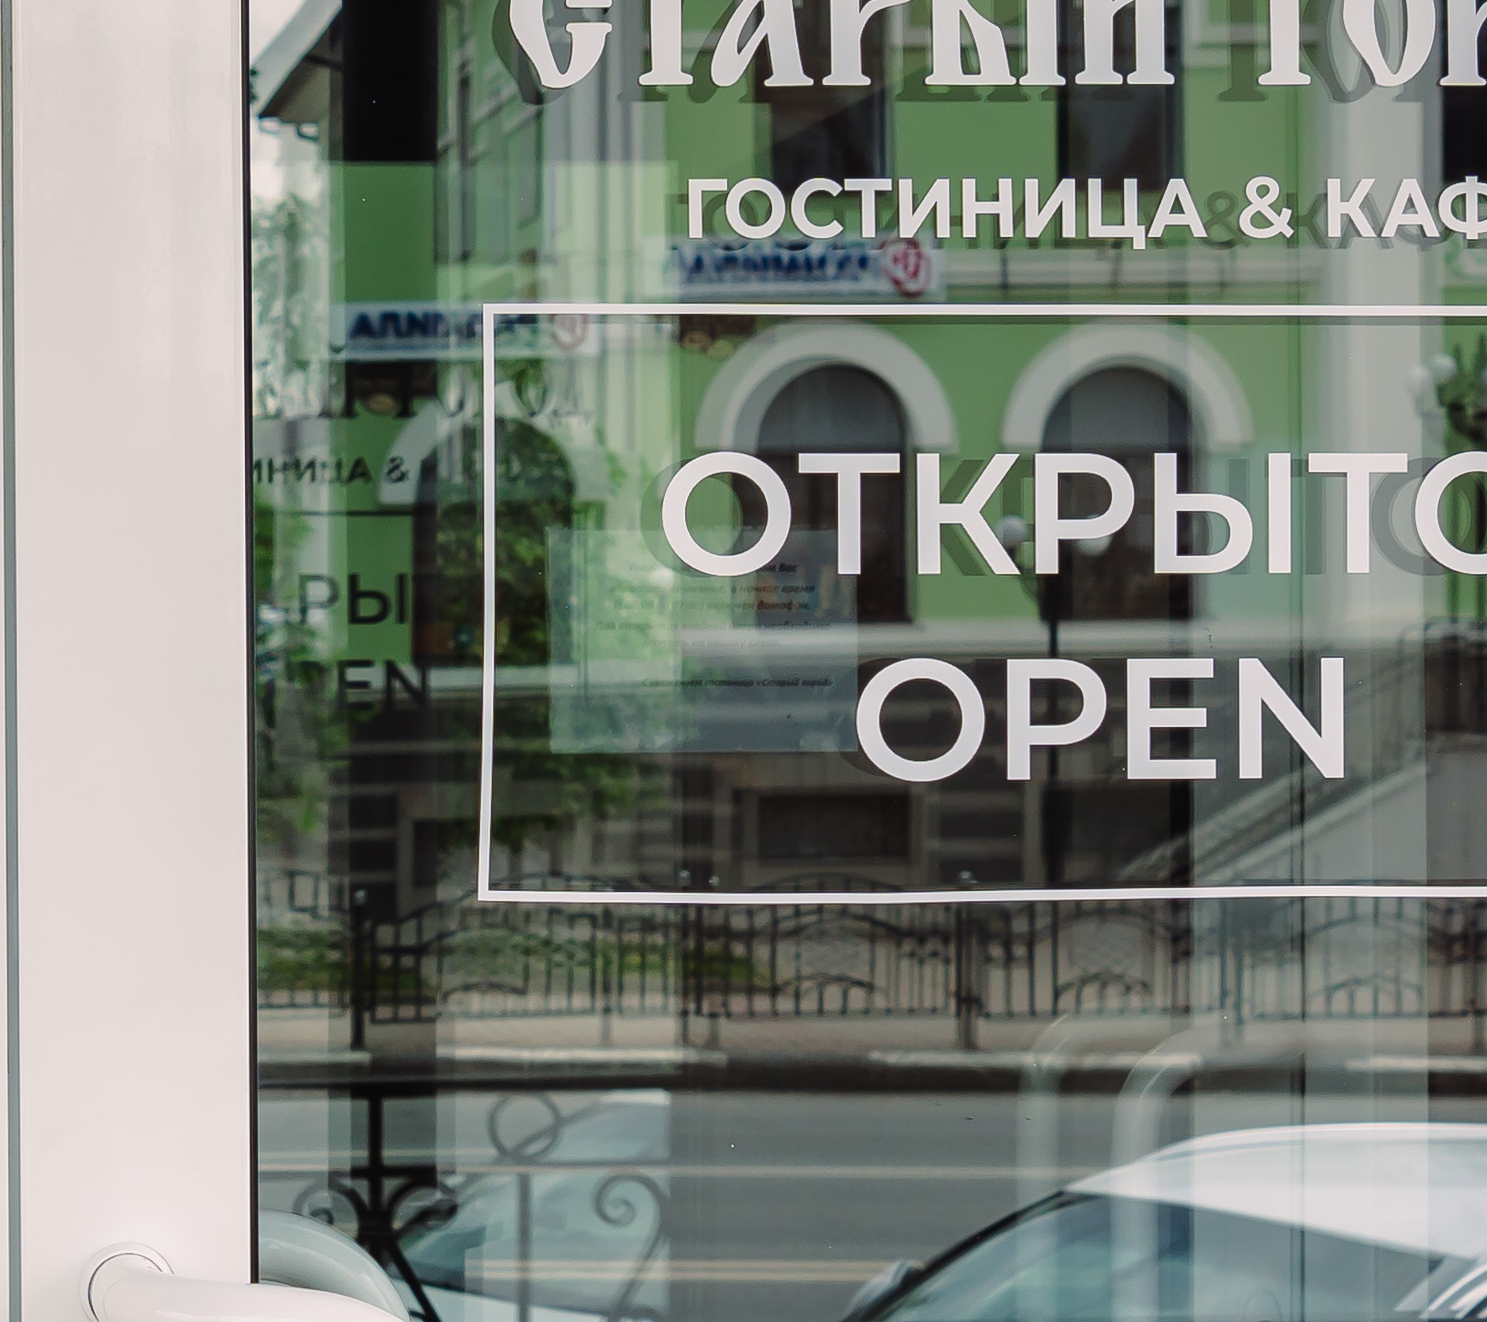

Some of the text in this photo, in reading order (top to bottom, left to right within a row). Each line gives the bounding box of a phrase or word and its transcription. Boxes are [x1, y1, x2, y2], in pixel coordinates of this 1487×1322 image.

[688, 177, 1208, 250] ГОСТИНИЦА
[1239, 176, 1295, 239] &
[856, 657, 1345, 782] OPEN
